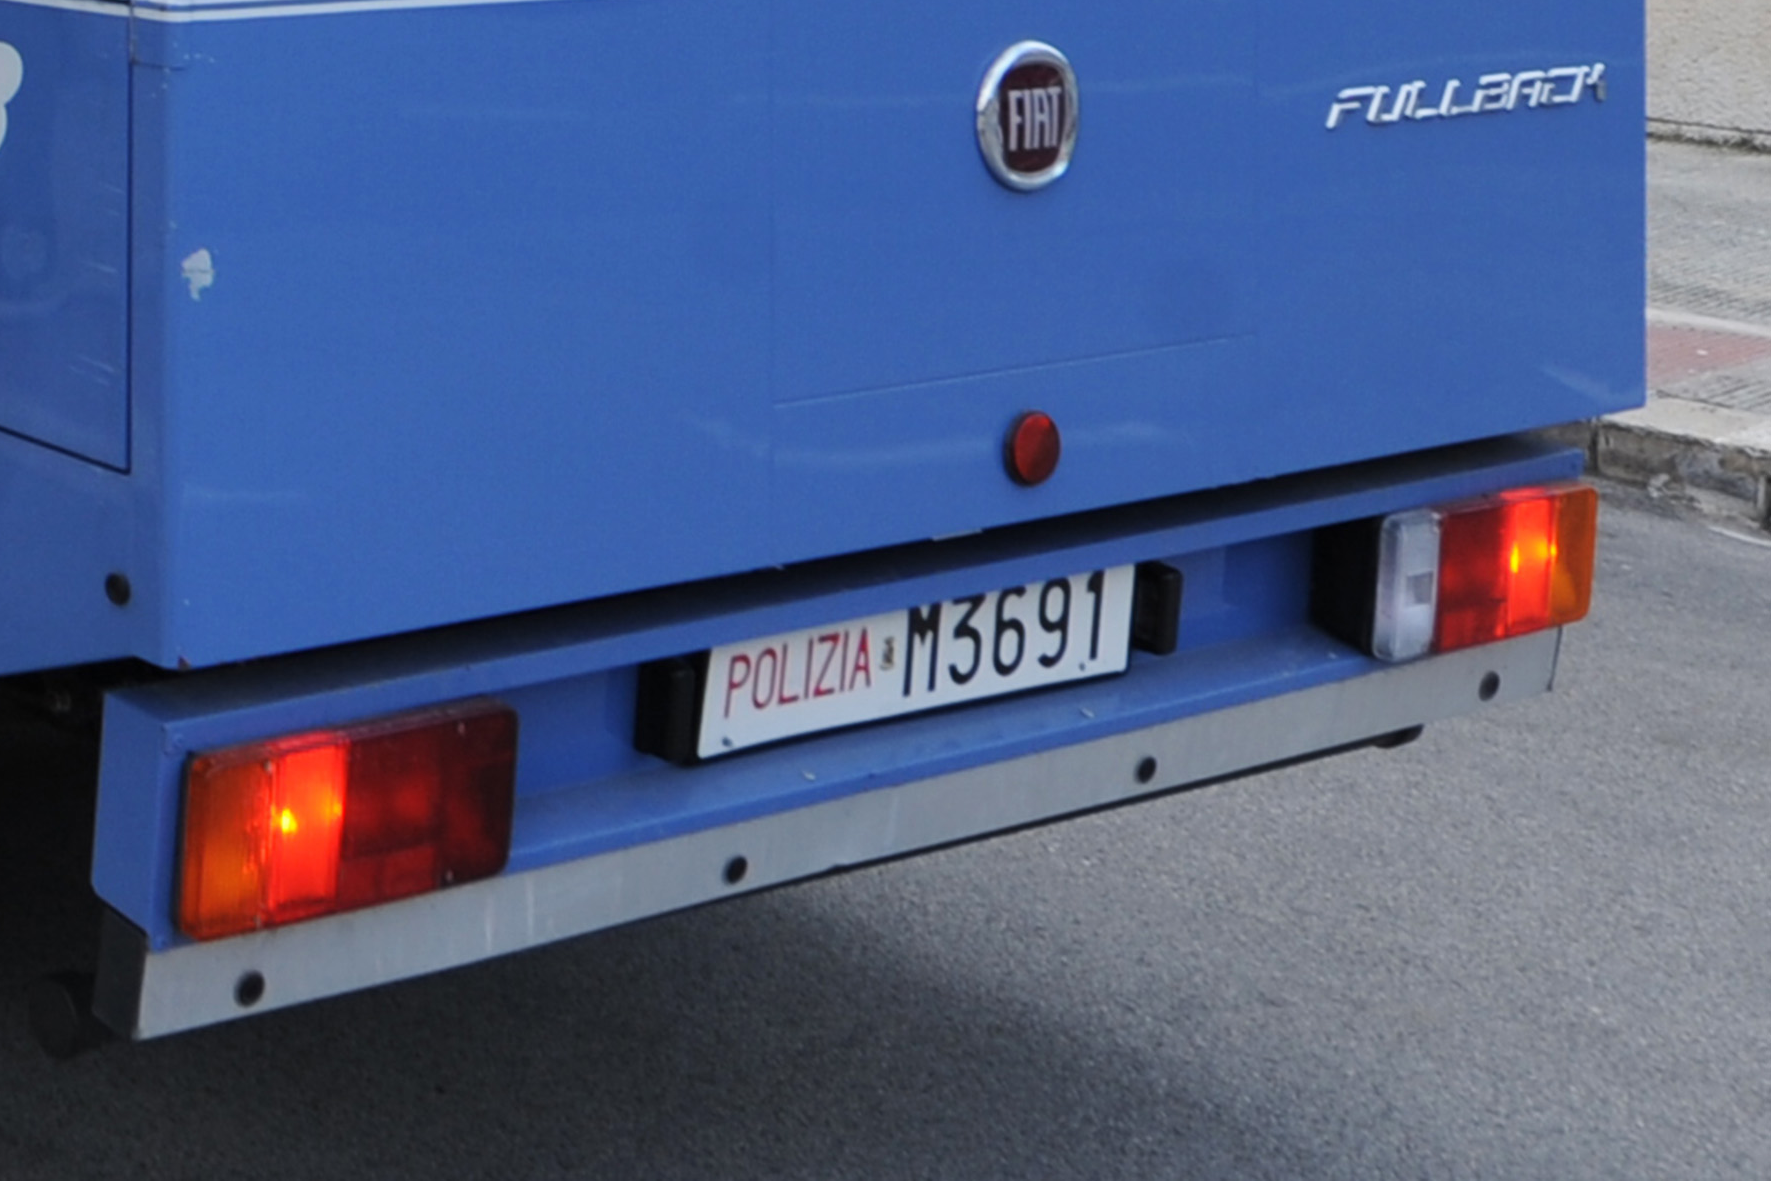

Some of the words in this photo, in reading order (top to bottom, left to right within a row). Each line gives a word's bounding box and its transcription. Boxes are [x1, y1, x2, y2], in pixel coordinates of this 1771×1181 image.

[1008, 86, 1062, 151] FIAT
[1326, 62, 1606, 128] FULLBACK
[724, 627, 871, 719] POLIZIA
[903, 569, 1105, 697] M3691
